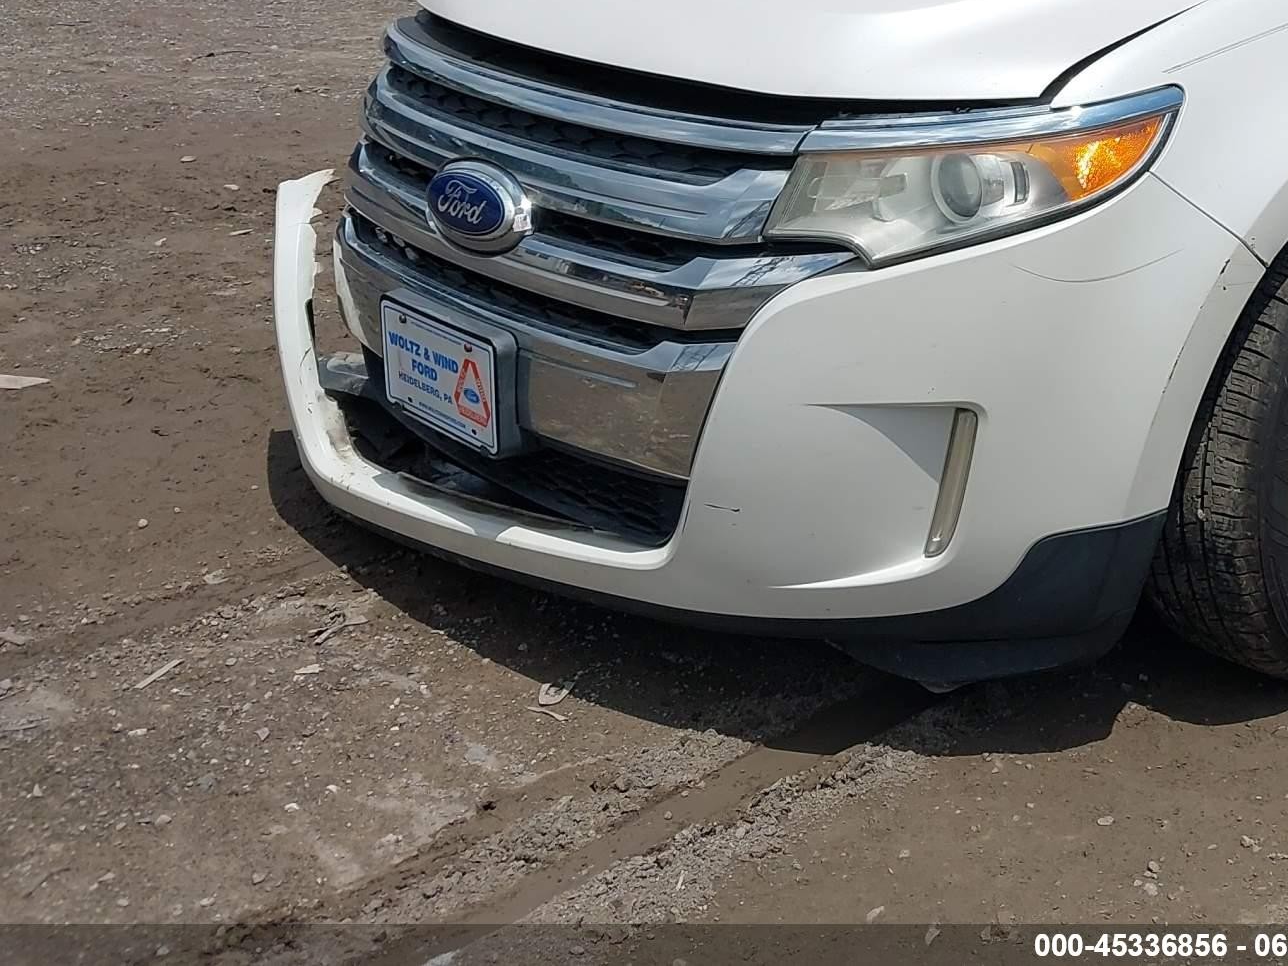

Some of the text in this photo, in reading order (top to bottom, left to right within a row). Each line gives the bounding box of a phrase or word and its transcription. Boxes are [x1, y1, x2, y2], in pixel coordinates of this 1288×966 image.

[437, 179, 487, 225] Ford
[388, 331, 421, 356] WOLTZ
[423, 346, 431, 362] &
[432, 350, 459, 374] WIND
[411, 358, 438, 382] FORD
